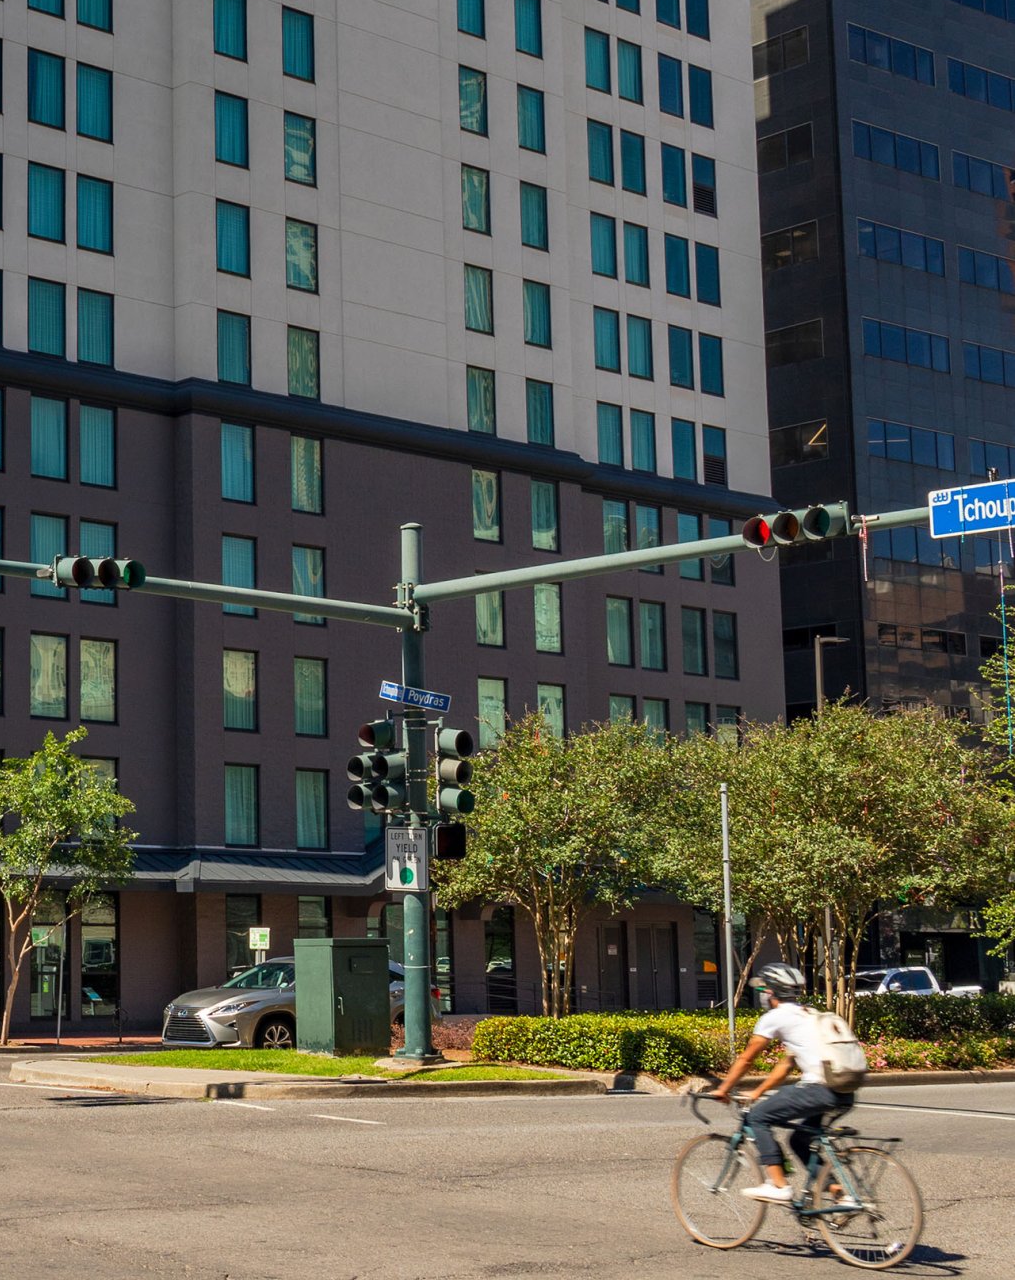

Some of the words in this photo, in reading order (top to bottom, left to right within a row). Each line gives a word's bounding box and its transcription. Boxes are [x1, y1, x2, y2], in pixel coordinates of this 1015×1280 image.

[408, 689, 445, 707] Poydras
[390, 832, 404, 840] LEFT
[395, 843, 418, 853] YIELD
